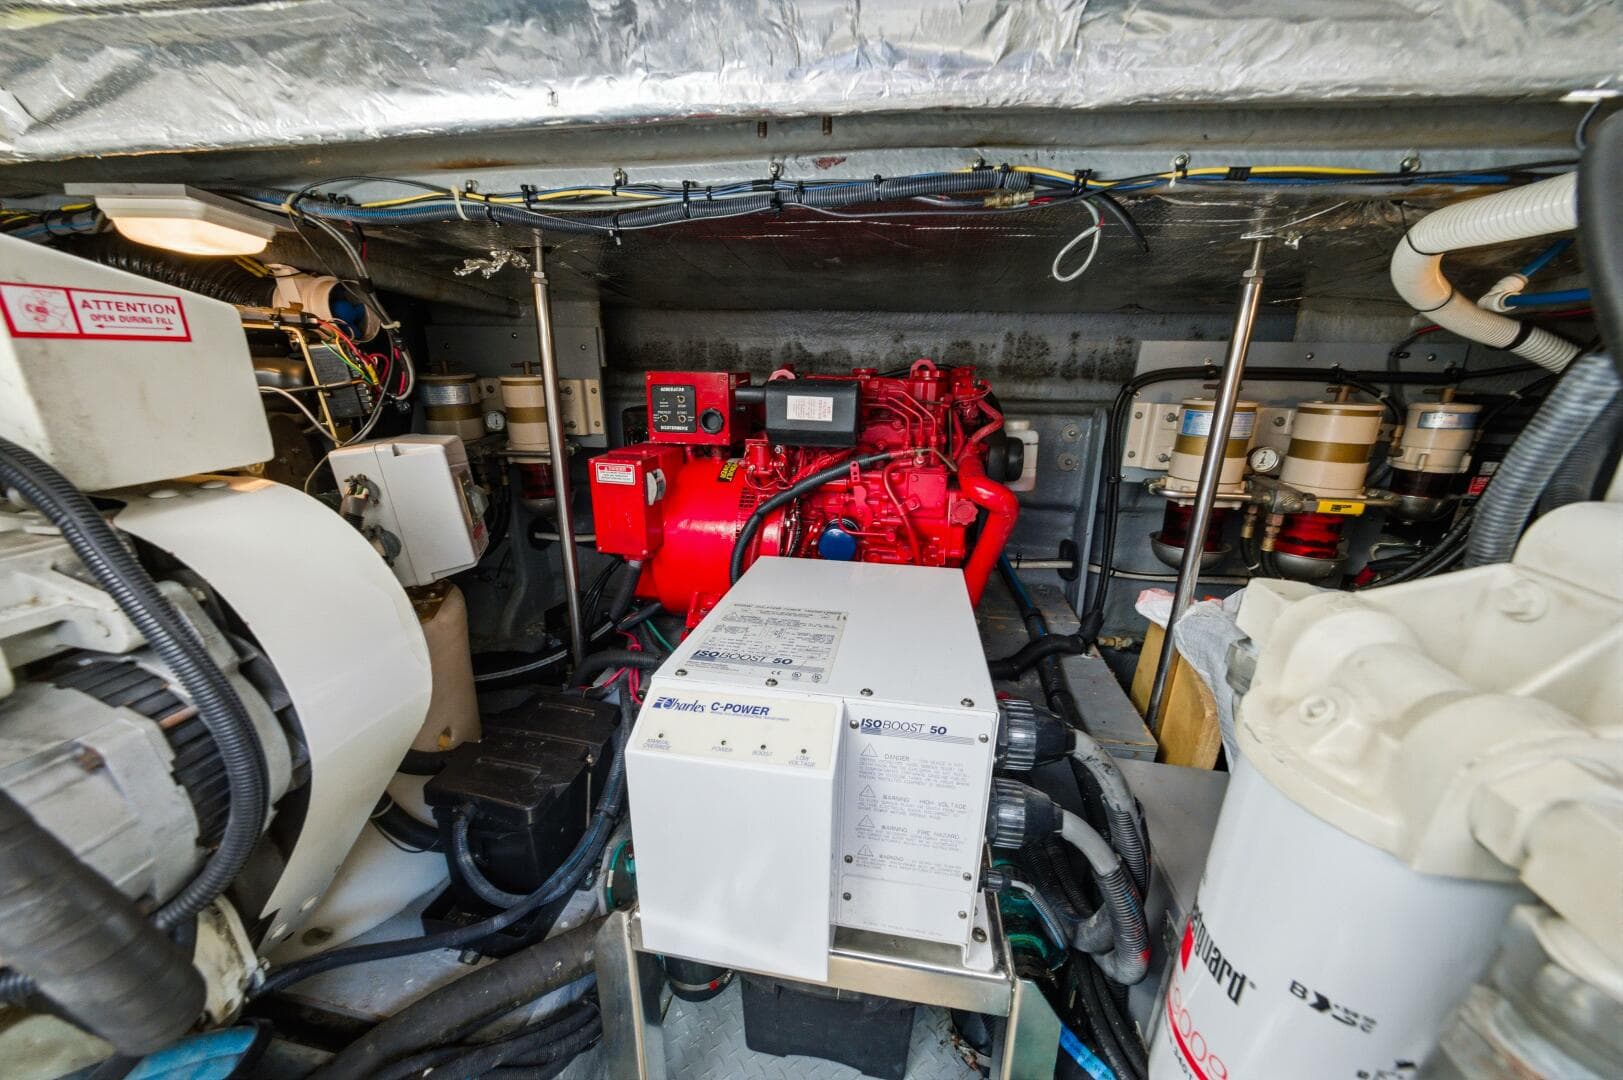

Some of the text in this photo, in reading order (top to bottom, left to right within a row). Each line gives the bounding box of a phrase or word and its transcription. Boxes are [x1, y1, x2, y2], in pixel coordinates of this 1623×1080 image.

[81, 299, 176, 315] ATTENTION
[90, 314, 174, 326] OPEN DURING FILL
[693, 648, 793, 666] ISOBOOST 50
[710, 701, 770, 716] C-POWER
[861, 717, 948, 735] ISOBOOST 50
